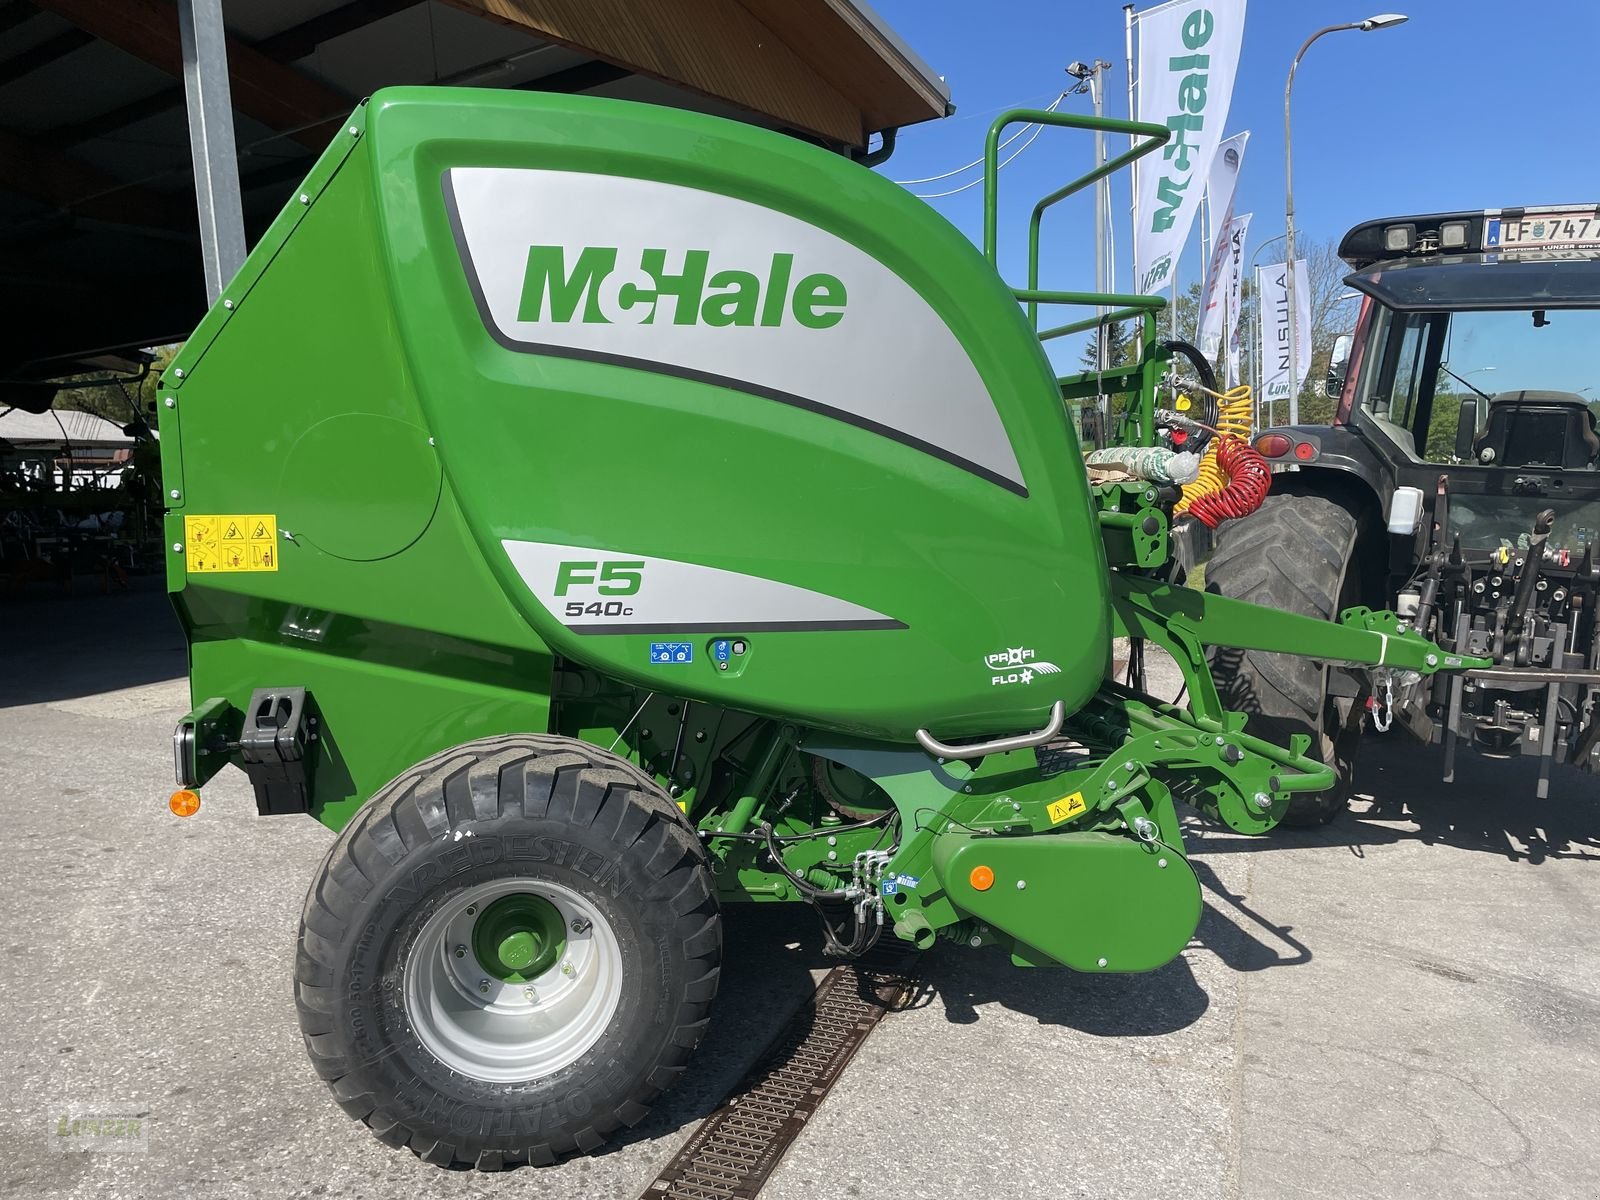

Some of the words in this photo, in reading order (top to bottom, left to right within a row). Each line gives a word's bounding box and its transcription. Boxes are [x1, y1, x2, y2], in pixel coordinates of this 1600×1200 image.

[1151, 9, 1214, 233] McHale
[1504, 221, 1532, 241] LF
[517, 245, 848, 329] McHale
[1275, 273, 1289, 371] NISULA
[554, 561, 645, 597] F5
[385, 834, 633, 899] VREDESTEIN
